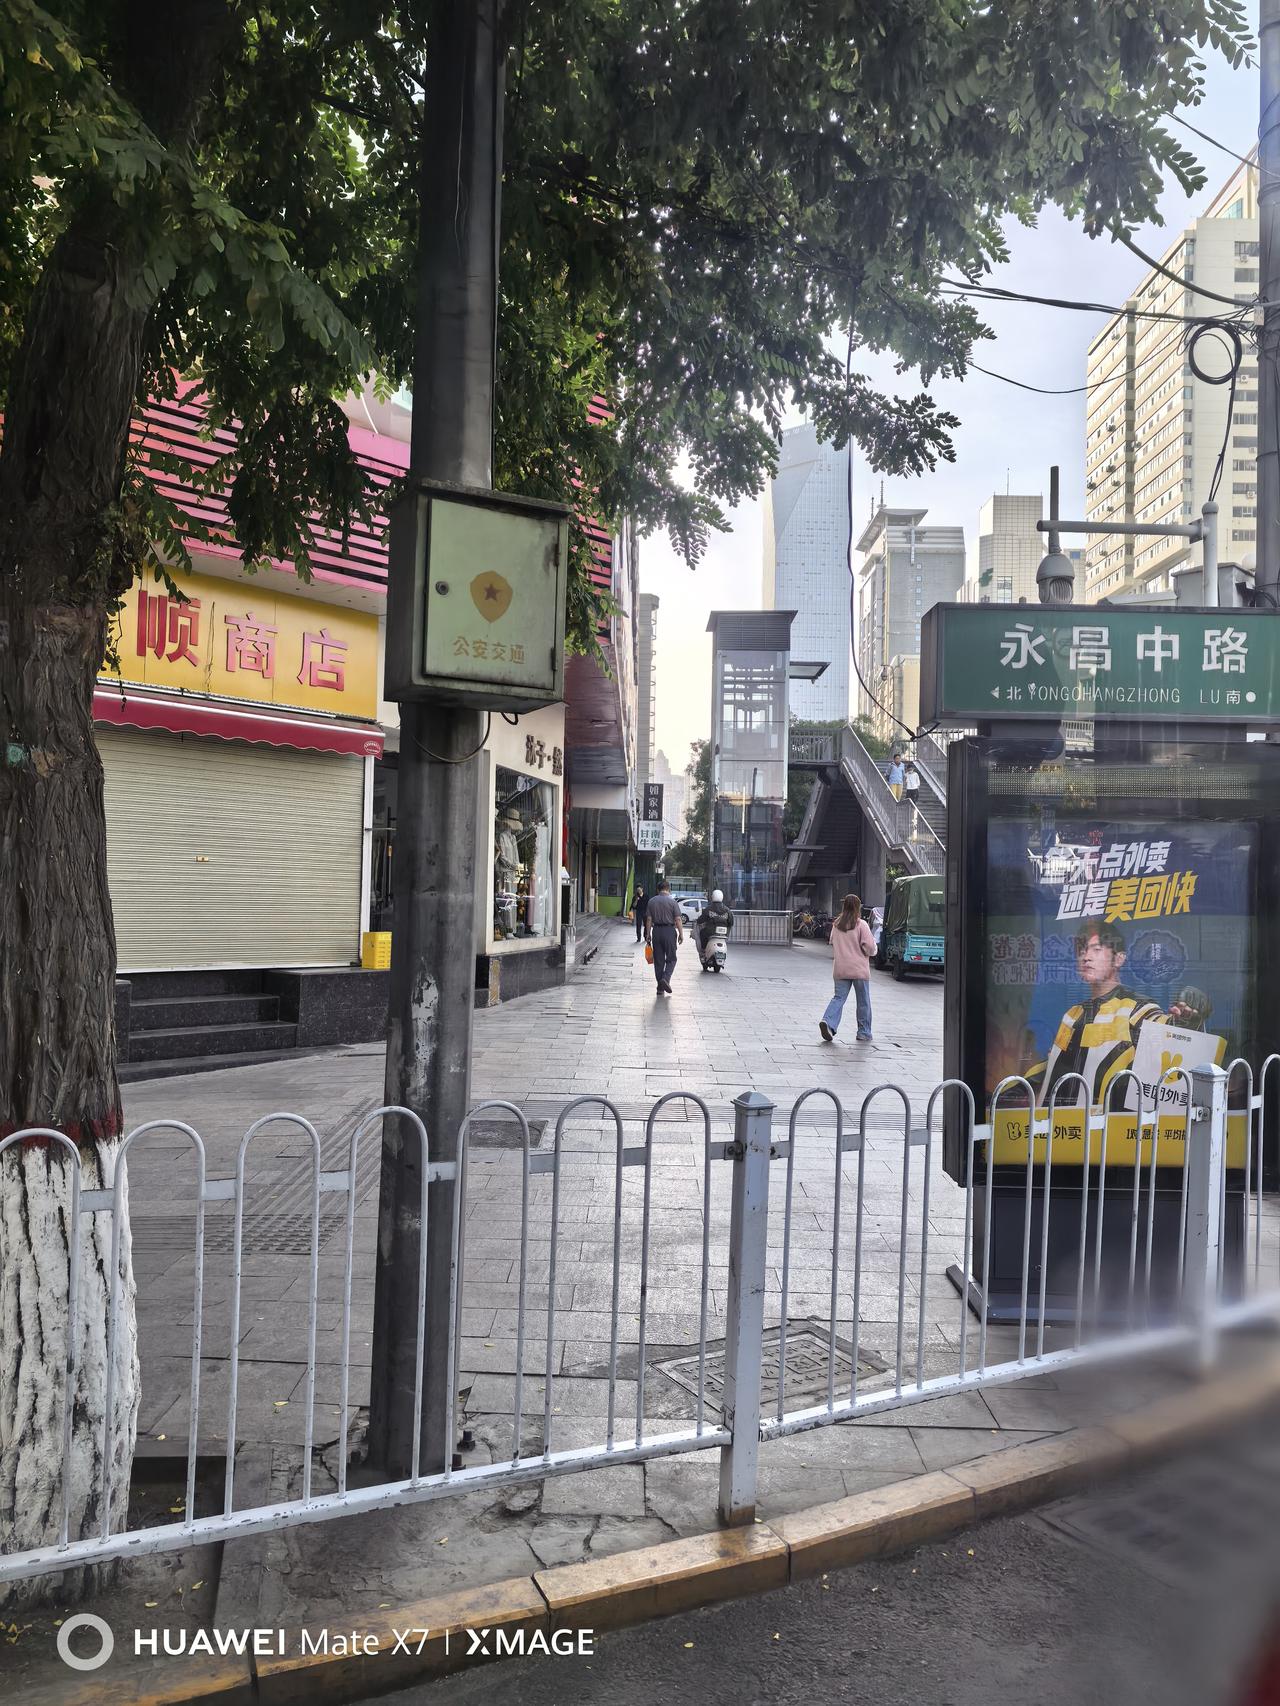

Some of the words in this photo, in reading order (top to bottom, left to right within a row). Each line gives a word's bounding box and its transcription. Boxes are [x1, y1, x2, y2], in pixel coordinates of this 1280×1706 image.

[137, 590, 347, 692] 顺商店
[453, 636, 525, 665] 公安交通
[1000, 622, 1249, 674] 永昌中路
[1006, 686, 1022, 701] 北
[1200, 689, 1220, 704] LU
[1225, 690, 1241, 705] 南
[1055, 870, 1199, 924] 还是美团快
